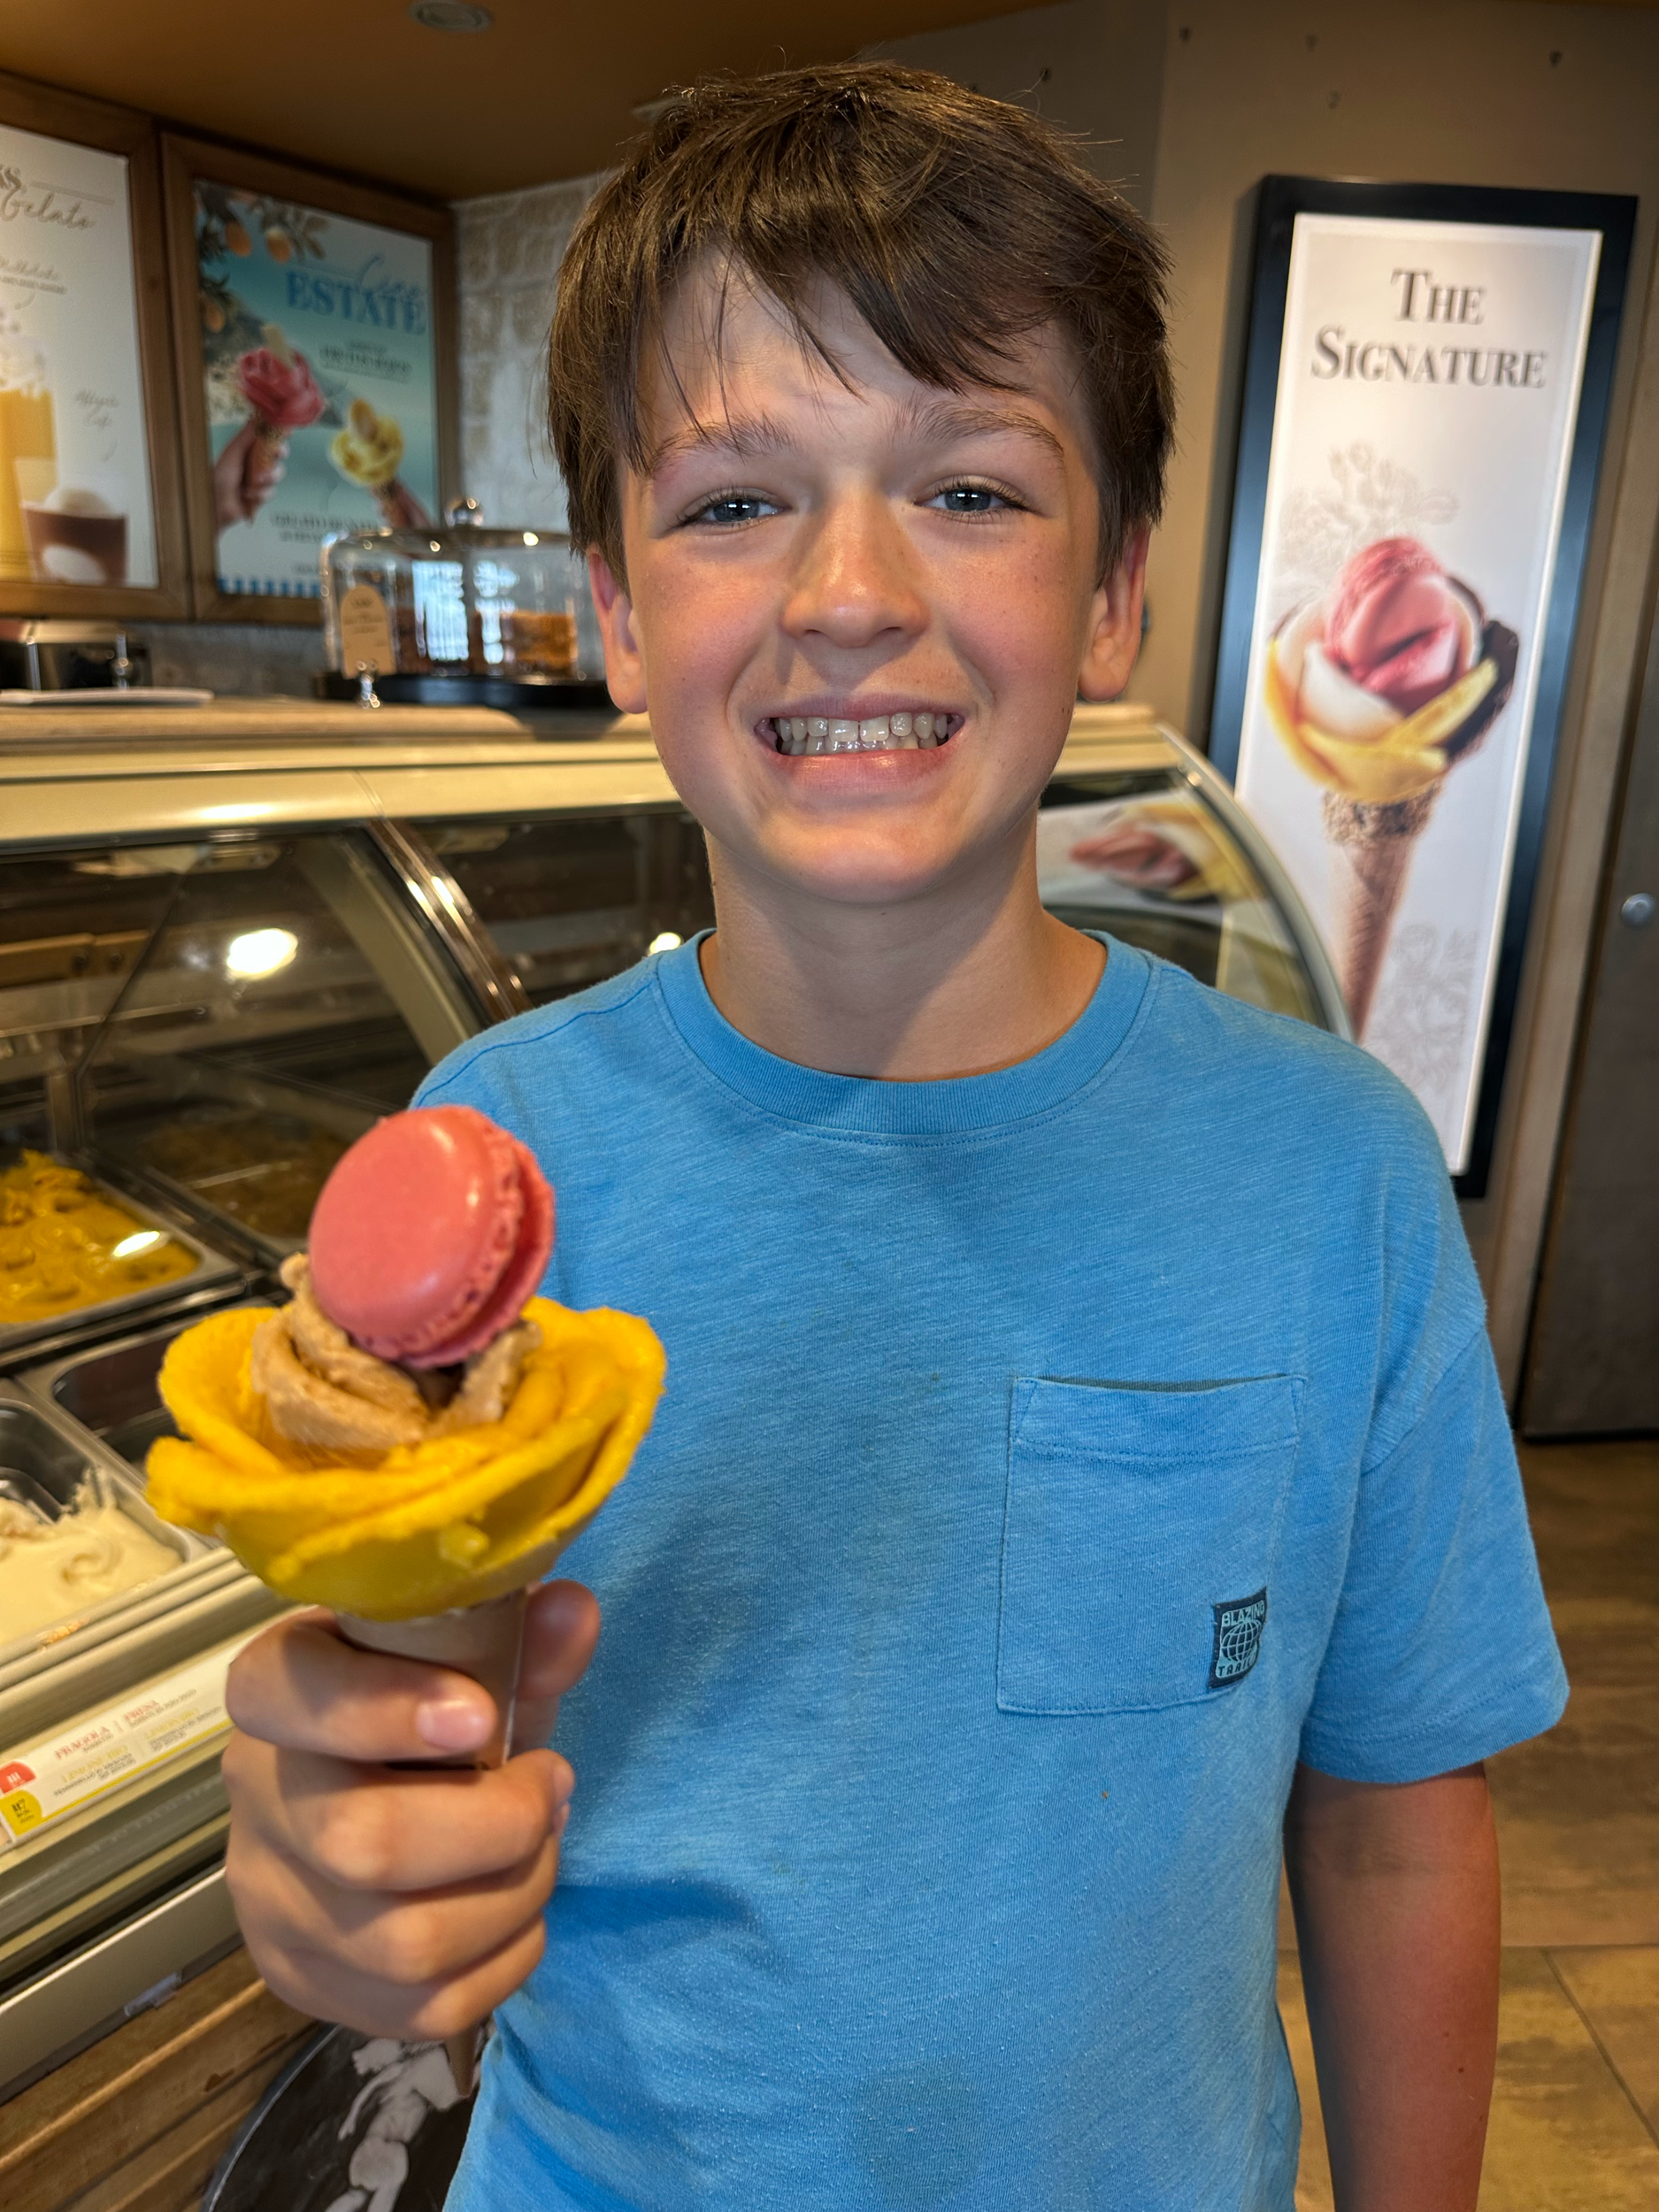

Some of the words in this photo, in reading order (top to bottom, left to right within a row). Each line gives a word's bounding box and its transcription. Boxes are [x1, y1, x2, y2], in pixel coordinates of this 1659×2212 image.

[1390, 267, 1486, 325] THE
[1310, 322, 1549, 388] SIGNATURE
[1221, 1600, 1265, 1627] BLAZING
